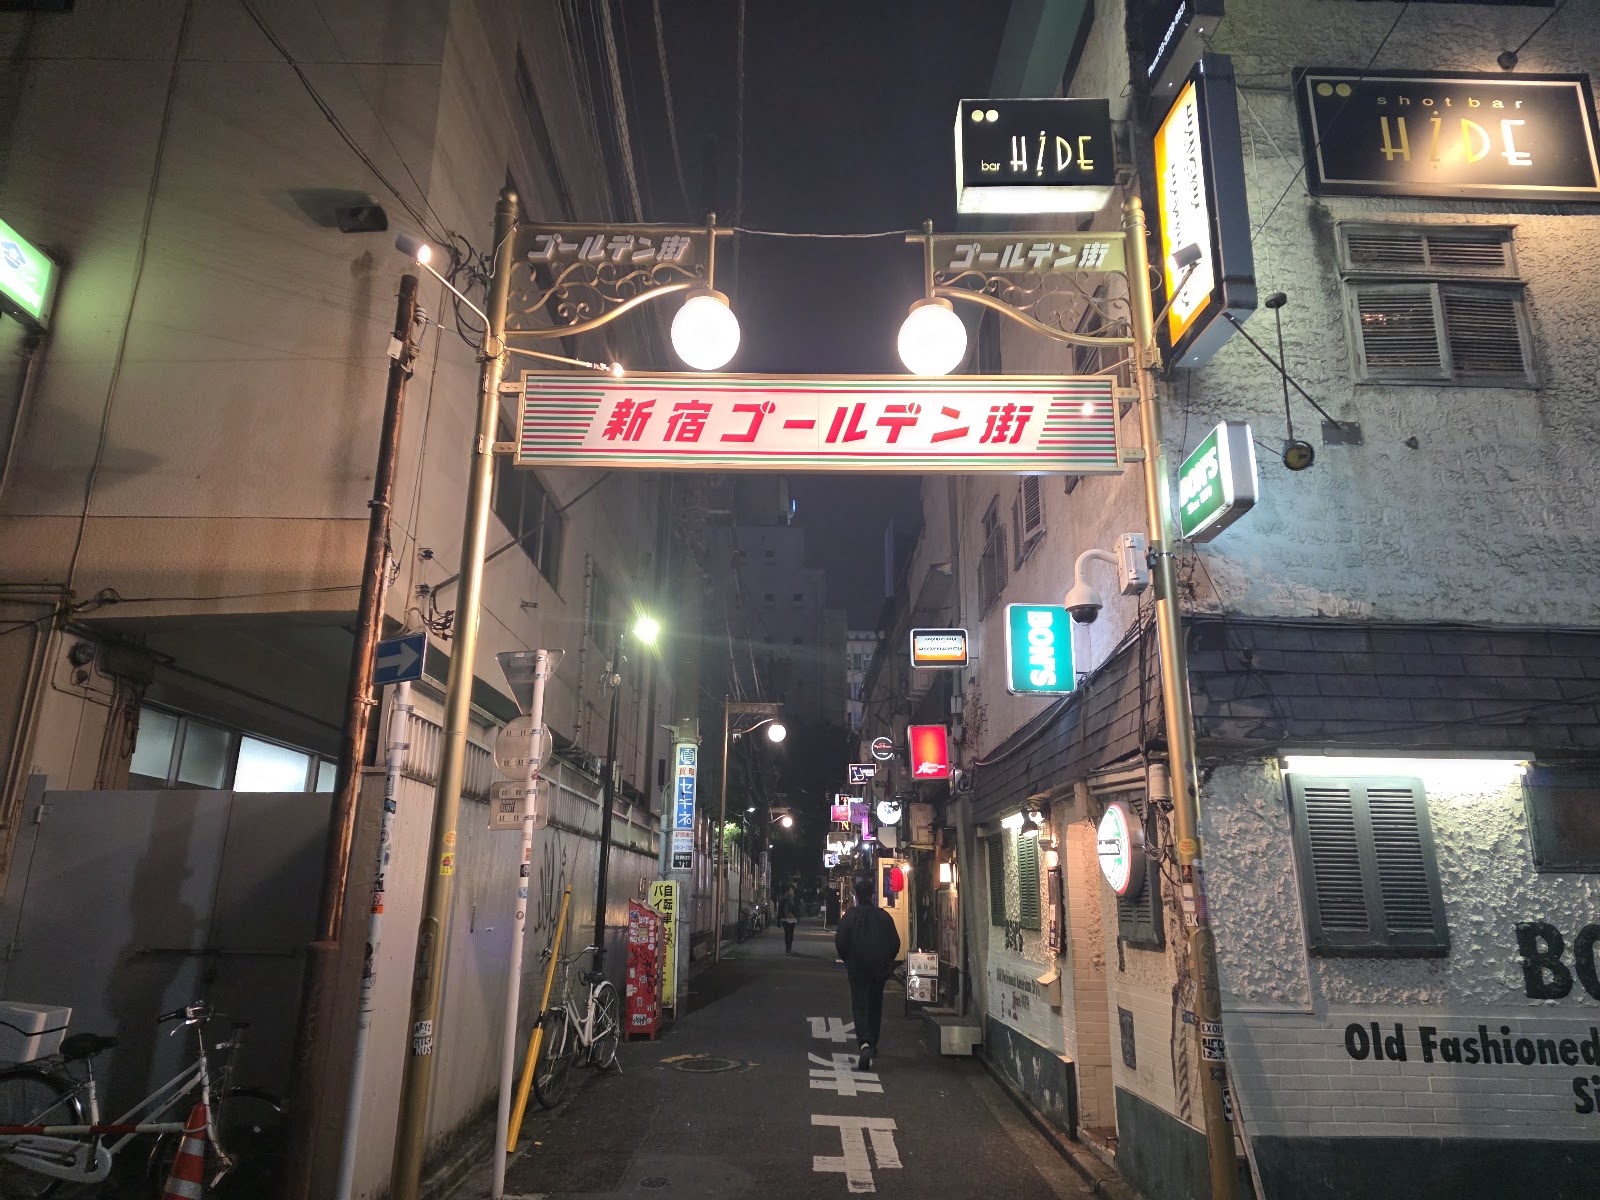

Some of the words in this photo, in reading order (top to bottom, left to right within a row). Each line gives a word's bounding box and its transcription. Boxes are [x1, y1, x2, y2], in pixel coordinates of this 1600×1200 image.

[1376, 95, 1452, 107] shot
[1468, 97, 1523, 109] bar
[981, 159, 1001, 172] bar
[527, 233, 691, 261] ゴールデン街
[949, 241, 1111, 268] ゴールデン街
[601, 397, 1032, 445] 新宿ゴールデン街
[678, 778, 693, 826] セキネ
[662, 884, 674, 925] 自転車
[1345, 1022, 1407, 1061] Old
[1418, 1024, 1600, 1066] Fashioned
